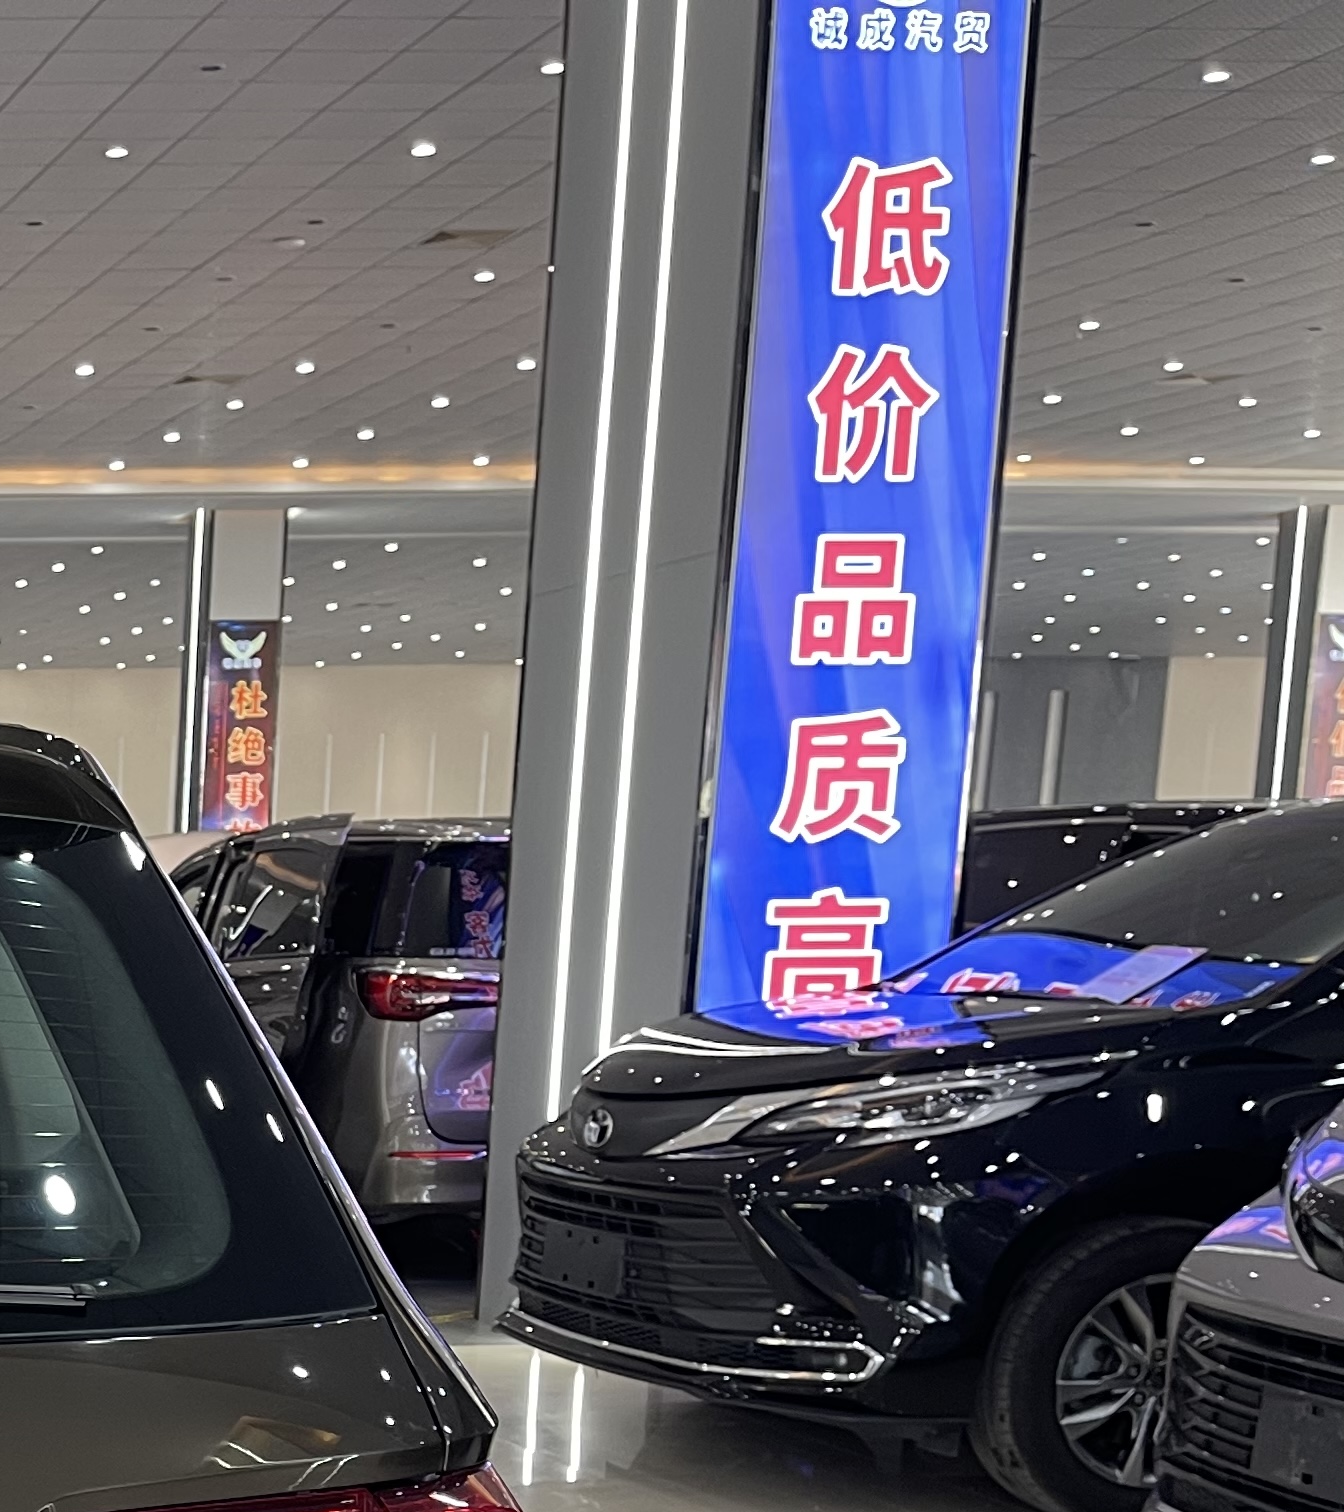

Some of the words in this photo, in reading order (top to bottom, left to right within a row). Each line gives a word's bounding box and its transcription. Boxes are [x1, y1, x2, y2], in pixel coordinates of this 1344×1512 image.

[809, 7, 991, 53] 诚成汽贸
[762, 157, 953, 1001] 低价品质高
